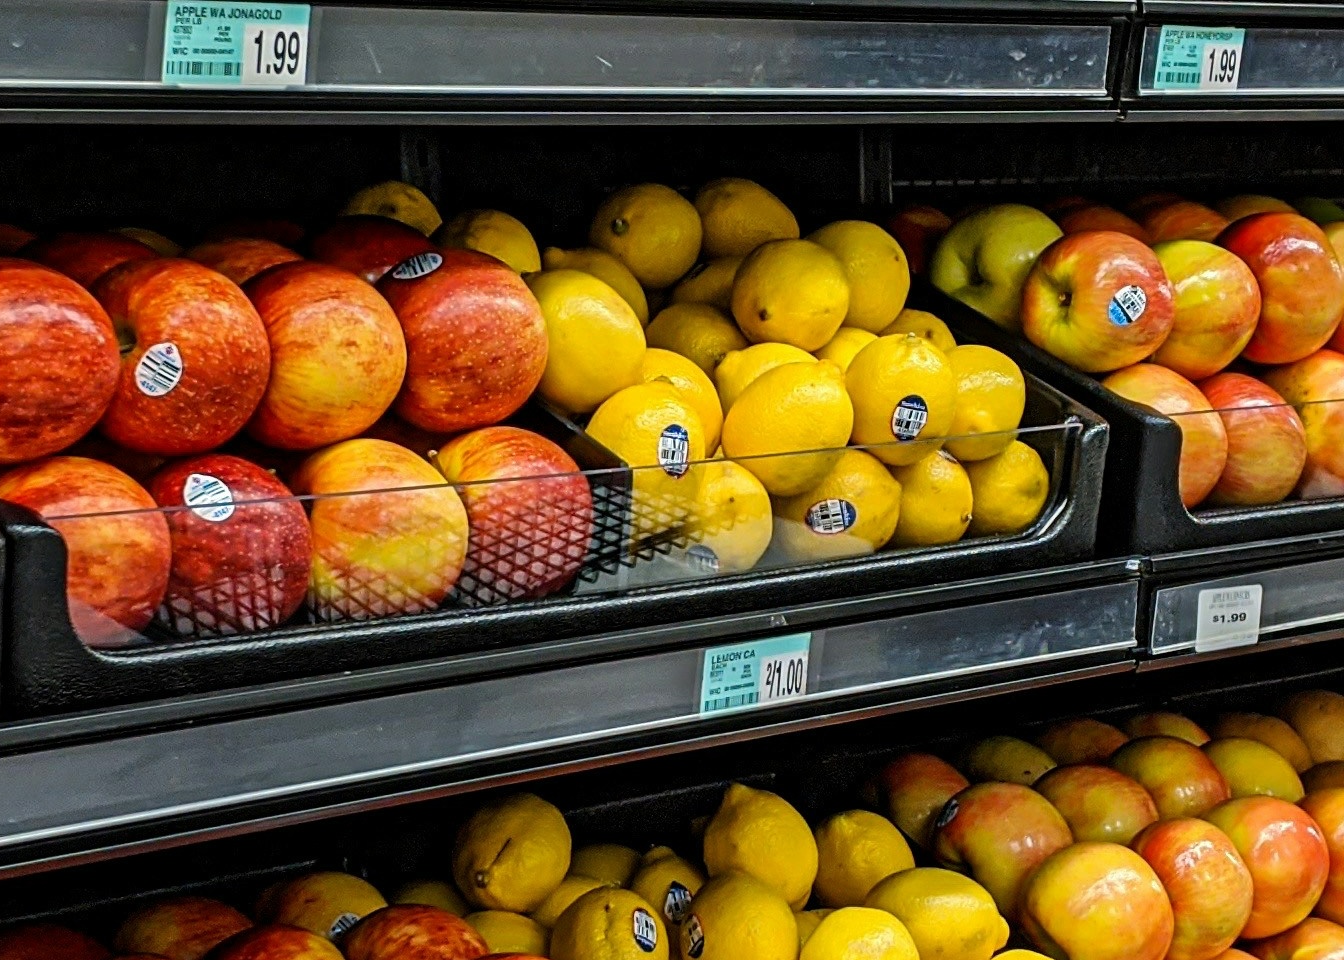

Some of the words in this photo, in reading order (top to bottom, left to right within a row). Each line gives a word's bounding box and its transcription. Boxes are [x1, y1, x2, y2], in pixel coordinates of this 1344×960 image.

[175, 6, 207, 18] APPLE
[210, 8, 226, 18] WA
[227, 8, 283, 21] JONAGOLD
[254, 29, 301, 75] 1.99
[1209, 48, 1237, 83] 1.99
[1212, 612, 1247, 624] $1.99
[711, 651, 742, 665] LEMON
[743, 649, 756, 660] CA
[765, 658, 804, 699] 2/1.00
